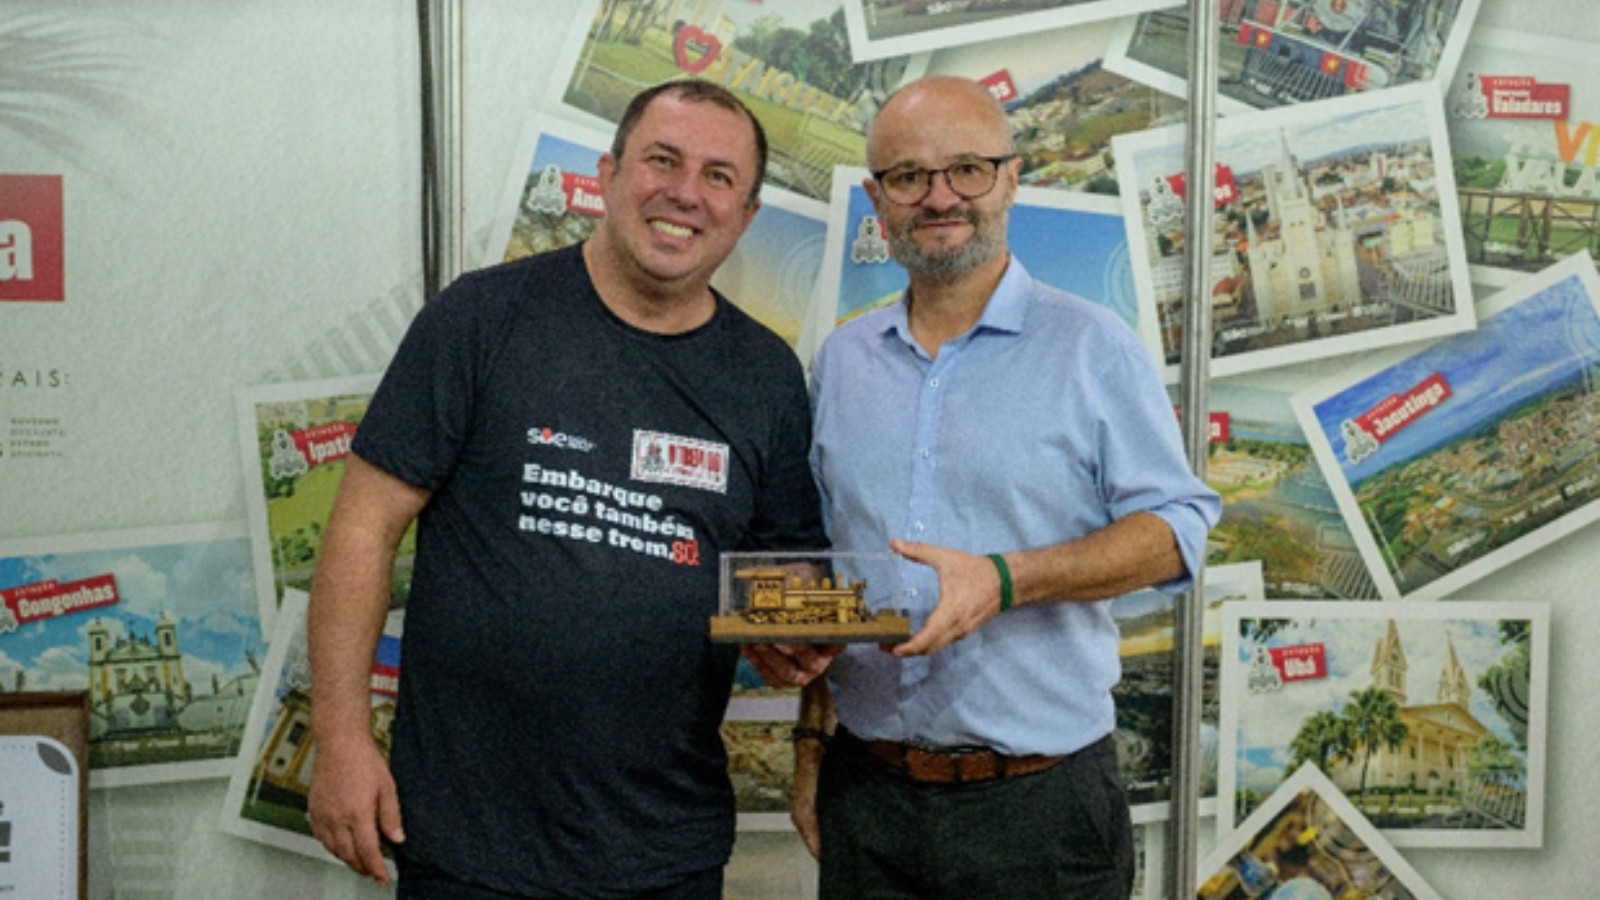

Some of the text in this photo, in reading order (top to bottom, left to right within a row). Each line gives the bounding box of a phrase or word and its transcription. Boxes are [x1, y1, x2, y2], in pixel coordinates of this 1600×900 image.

[1493, 100, 1562, 115] Valadares
[522, 462, 663, 511] Embarque
[520, 491, 590, 515] você
[518, 513, 603, 543] nesse
[594, 499, 694, 540] também
[18, 584, 115, 618] Congonhas
